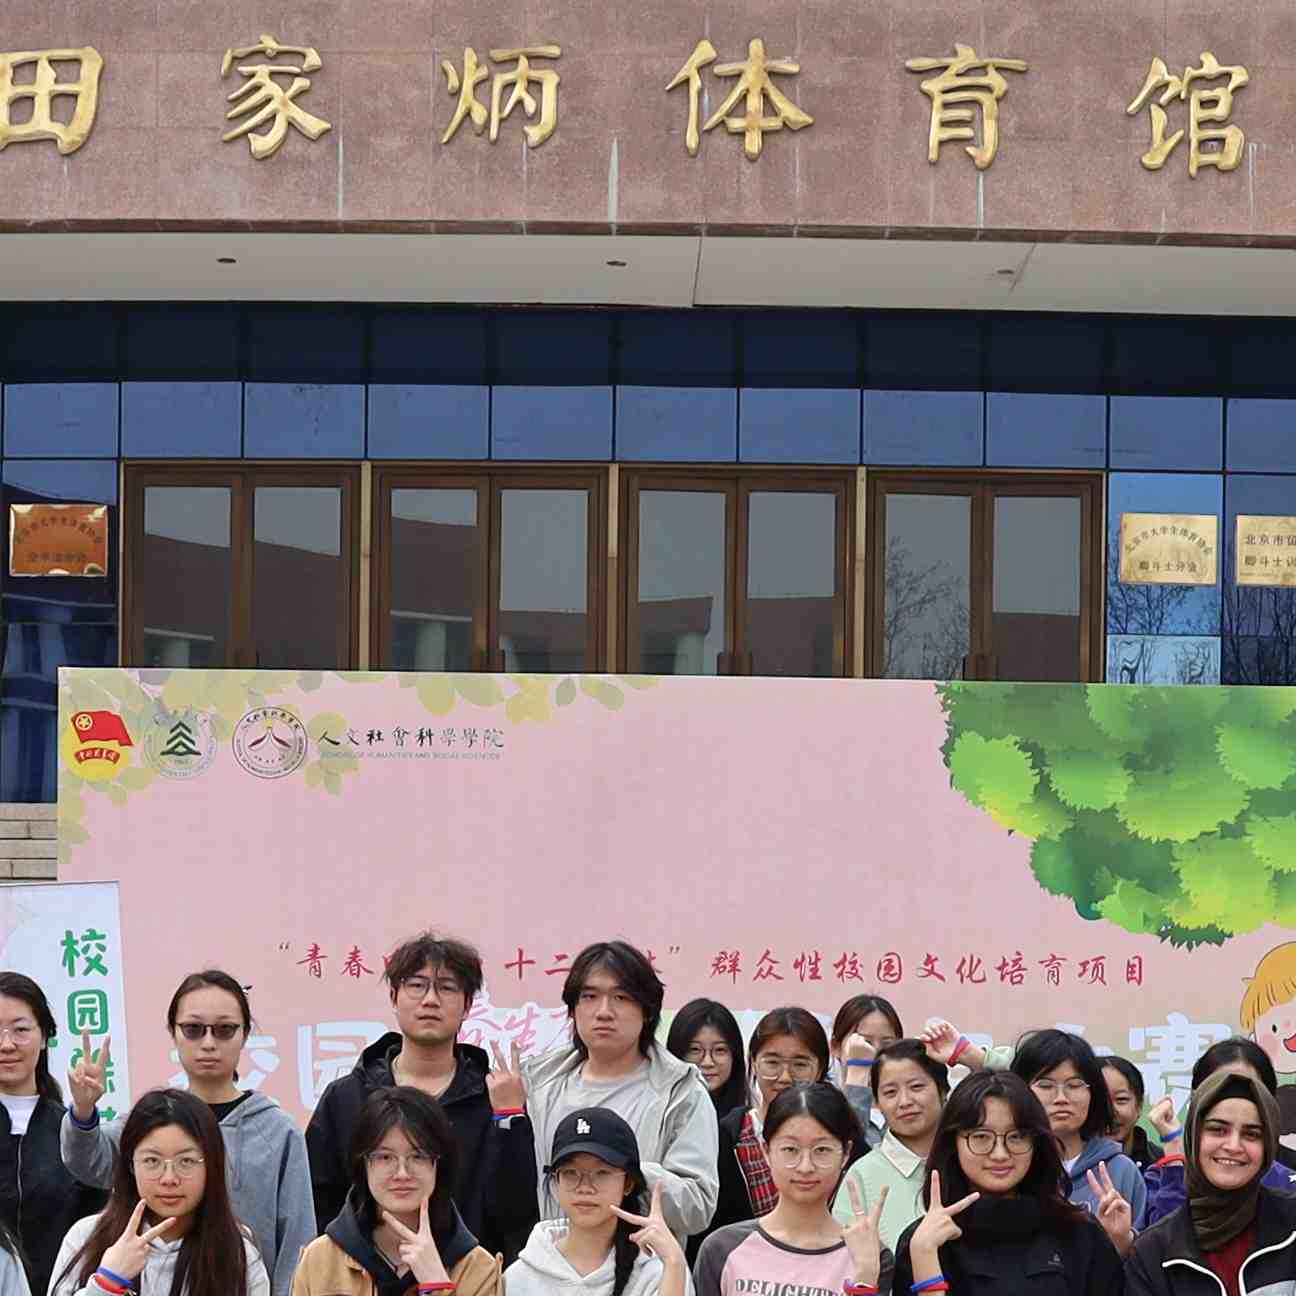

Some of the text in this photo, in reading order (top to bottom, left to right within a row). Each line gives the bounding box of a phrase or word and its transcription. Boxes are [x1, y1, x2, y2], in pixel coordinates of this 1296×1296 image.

[710, 949, 1146, 986] 群众性校园文化培育项目
